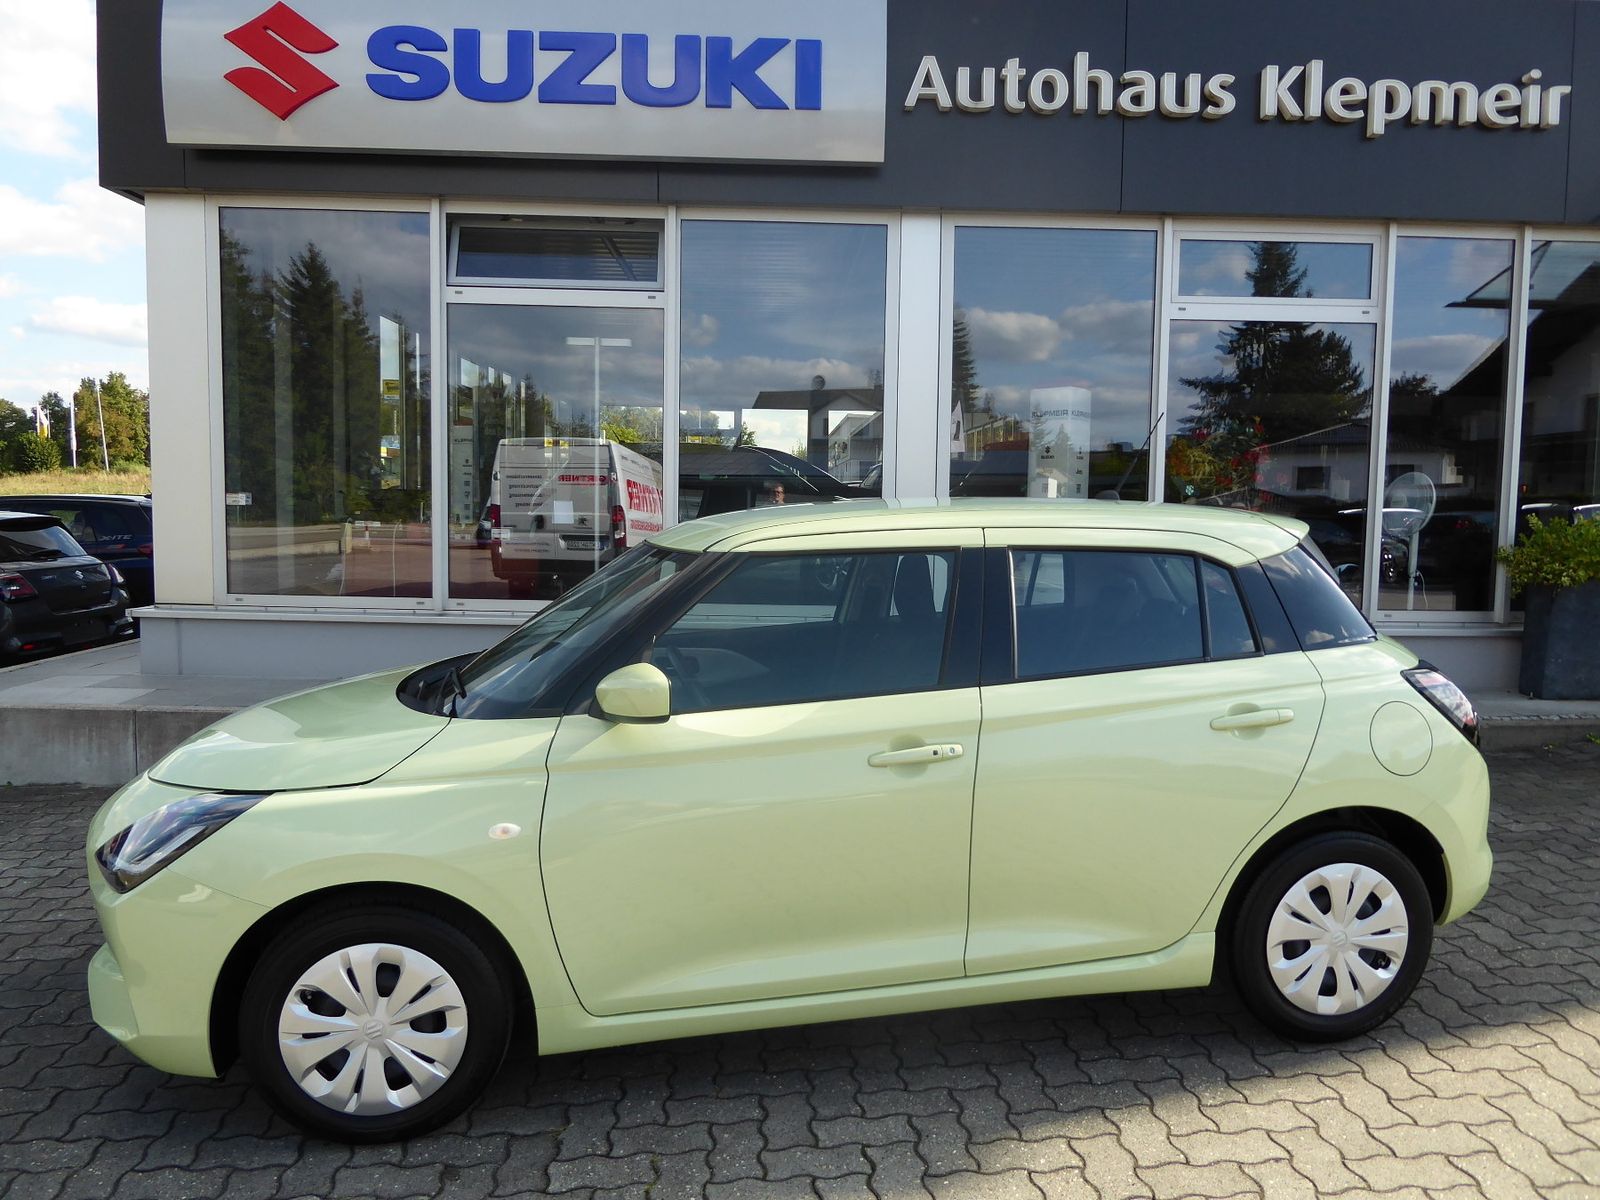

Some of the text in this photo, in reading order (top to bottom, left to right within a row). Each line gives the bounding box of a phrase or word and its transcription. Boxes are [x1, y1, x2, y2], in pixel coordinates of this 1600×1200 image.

[365, 25, 822, 112] SUZUKI
[904, 51, 1572, 138] Autohaus Klepmeir
